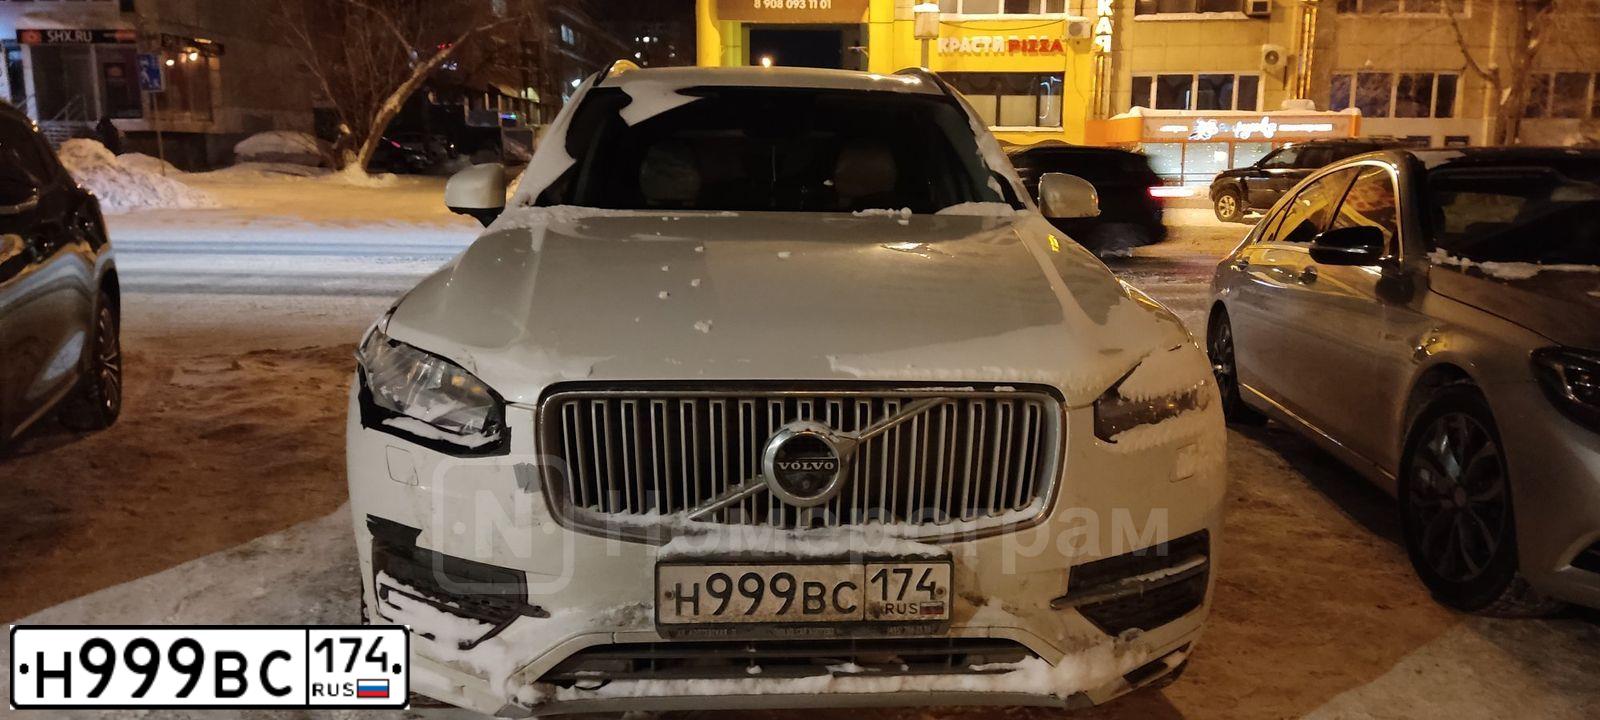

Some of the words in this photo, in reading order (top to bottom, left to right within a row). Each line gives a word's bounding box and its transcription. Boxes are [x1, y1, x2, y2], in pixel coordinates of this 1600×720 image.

[753, 0, 761, 9] 8
[763, 0, 784, 9] 908
[809, 0, 818, 9] 11
[819, 0, 832, 9] 01
[47, 30, 92, 42] SHX.RU
[1007, 38, 1064, 54] PIZZA
[777, 461, 834, 470] VOLVO
[675, 571, 858, 617] Н999ВС
[870, 567, 937, 602] 174
[884, 602, 918, 616] RUS
